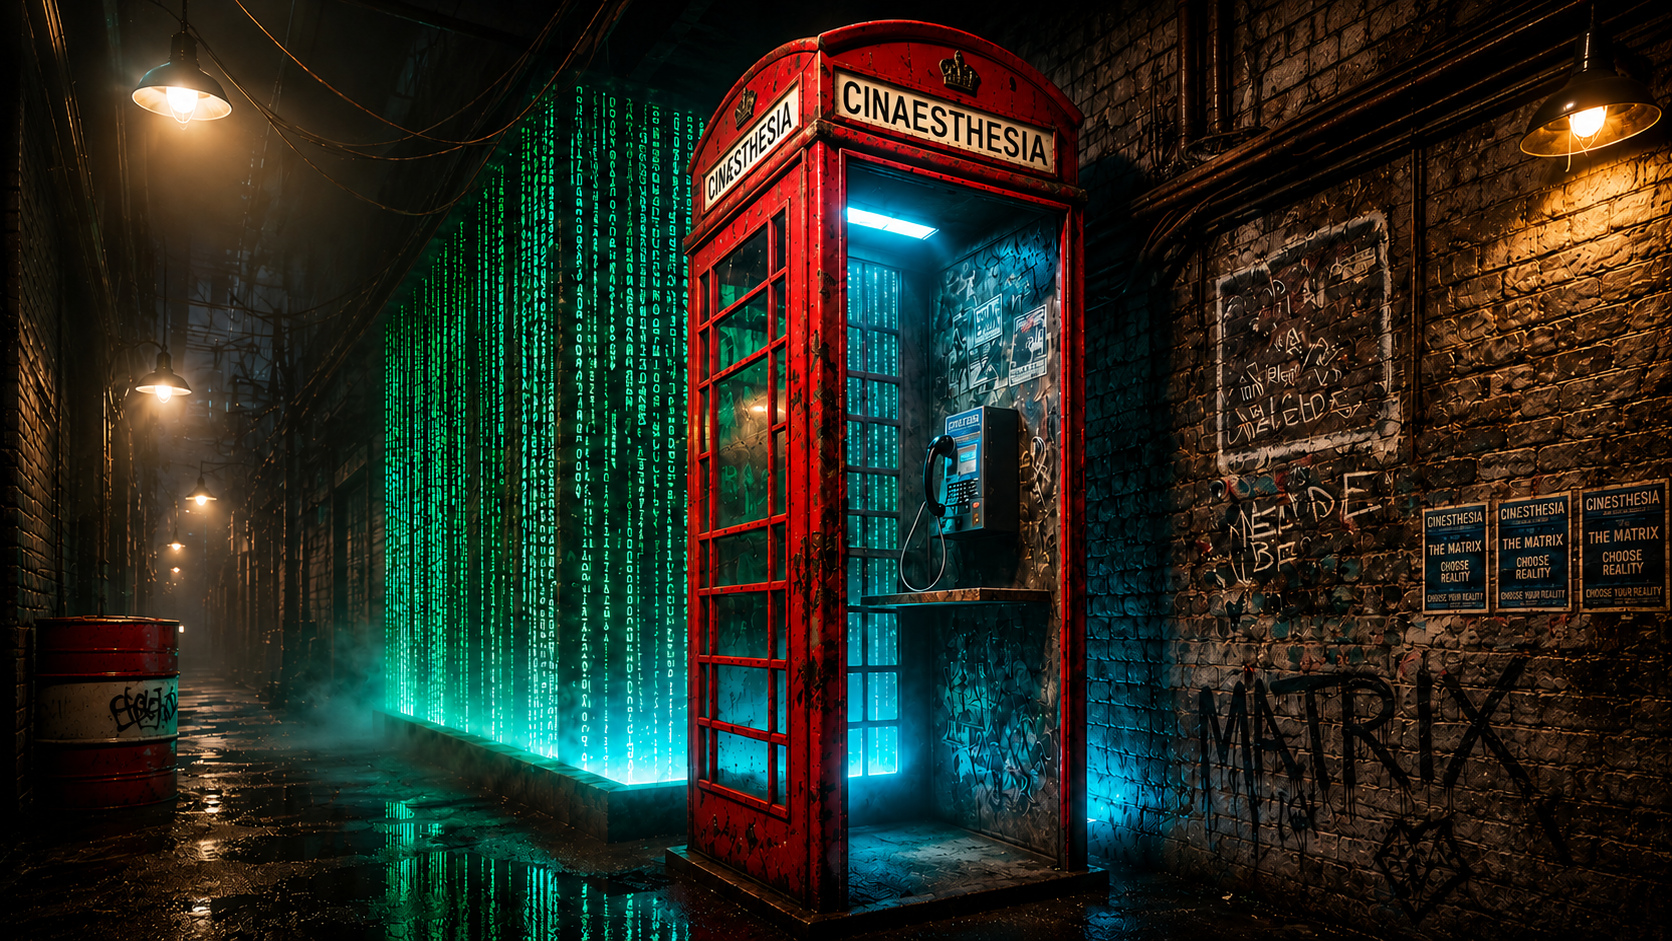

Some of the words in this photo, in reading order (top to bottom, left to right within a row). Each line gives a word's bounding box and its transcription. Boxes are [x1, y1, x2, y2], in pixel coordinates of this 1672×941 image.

[843, 81, 1048, 166] CINAESTHESIA
[1585, 489, 1660, 511] CINESTHESIA
[1500, 501, 1565, 520] CINESTHESIA
[1427, 511, 1483, 528] CINESTHESIA
[1502, 537, 1521, 550] THE
[1524, 533, 1563, 549] MATRIX
[1587, 530, 1610, 544] THE
[1613, 526, 1659, 542] MATRIX
[1428, 543, 1445, 556] THE
[1447, 540, 1482, 555] MATRIX
[1602, 549, 1643, 563] CHOOSE
[1516, 554, 1550, 567] CHOOSE
[1440, 571, 1470, 583] REALITY
[1515, 567, 1551, 580] REALITY
[1602, 562, 1644, 576] REALITY
[1633, 586, 1662, 596] REALITY
[1200, 656, 1548, 798] MATRIX
